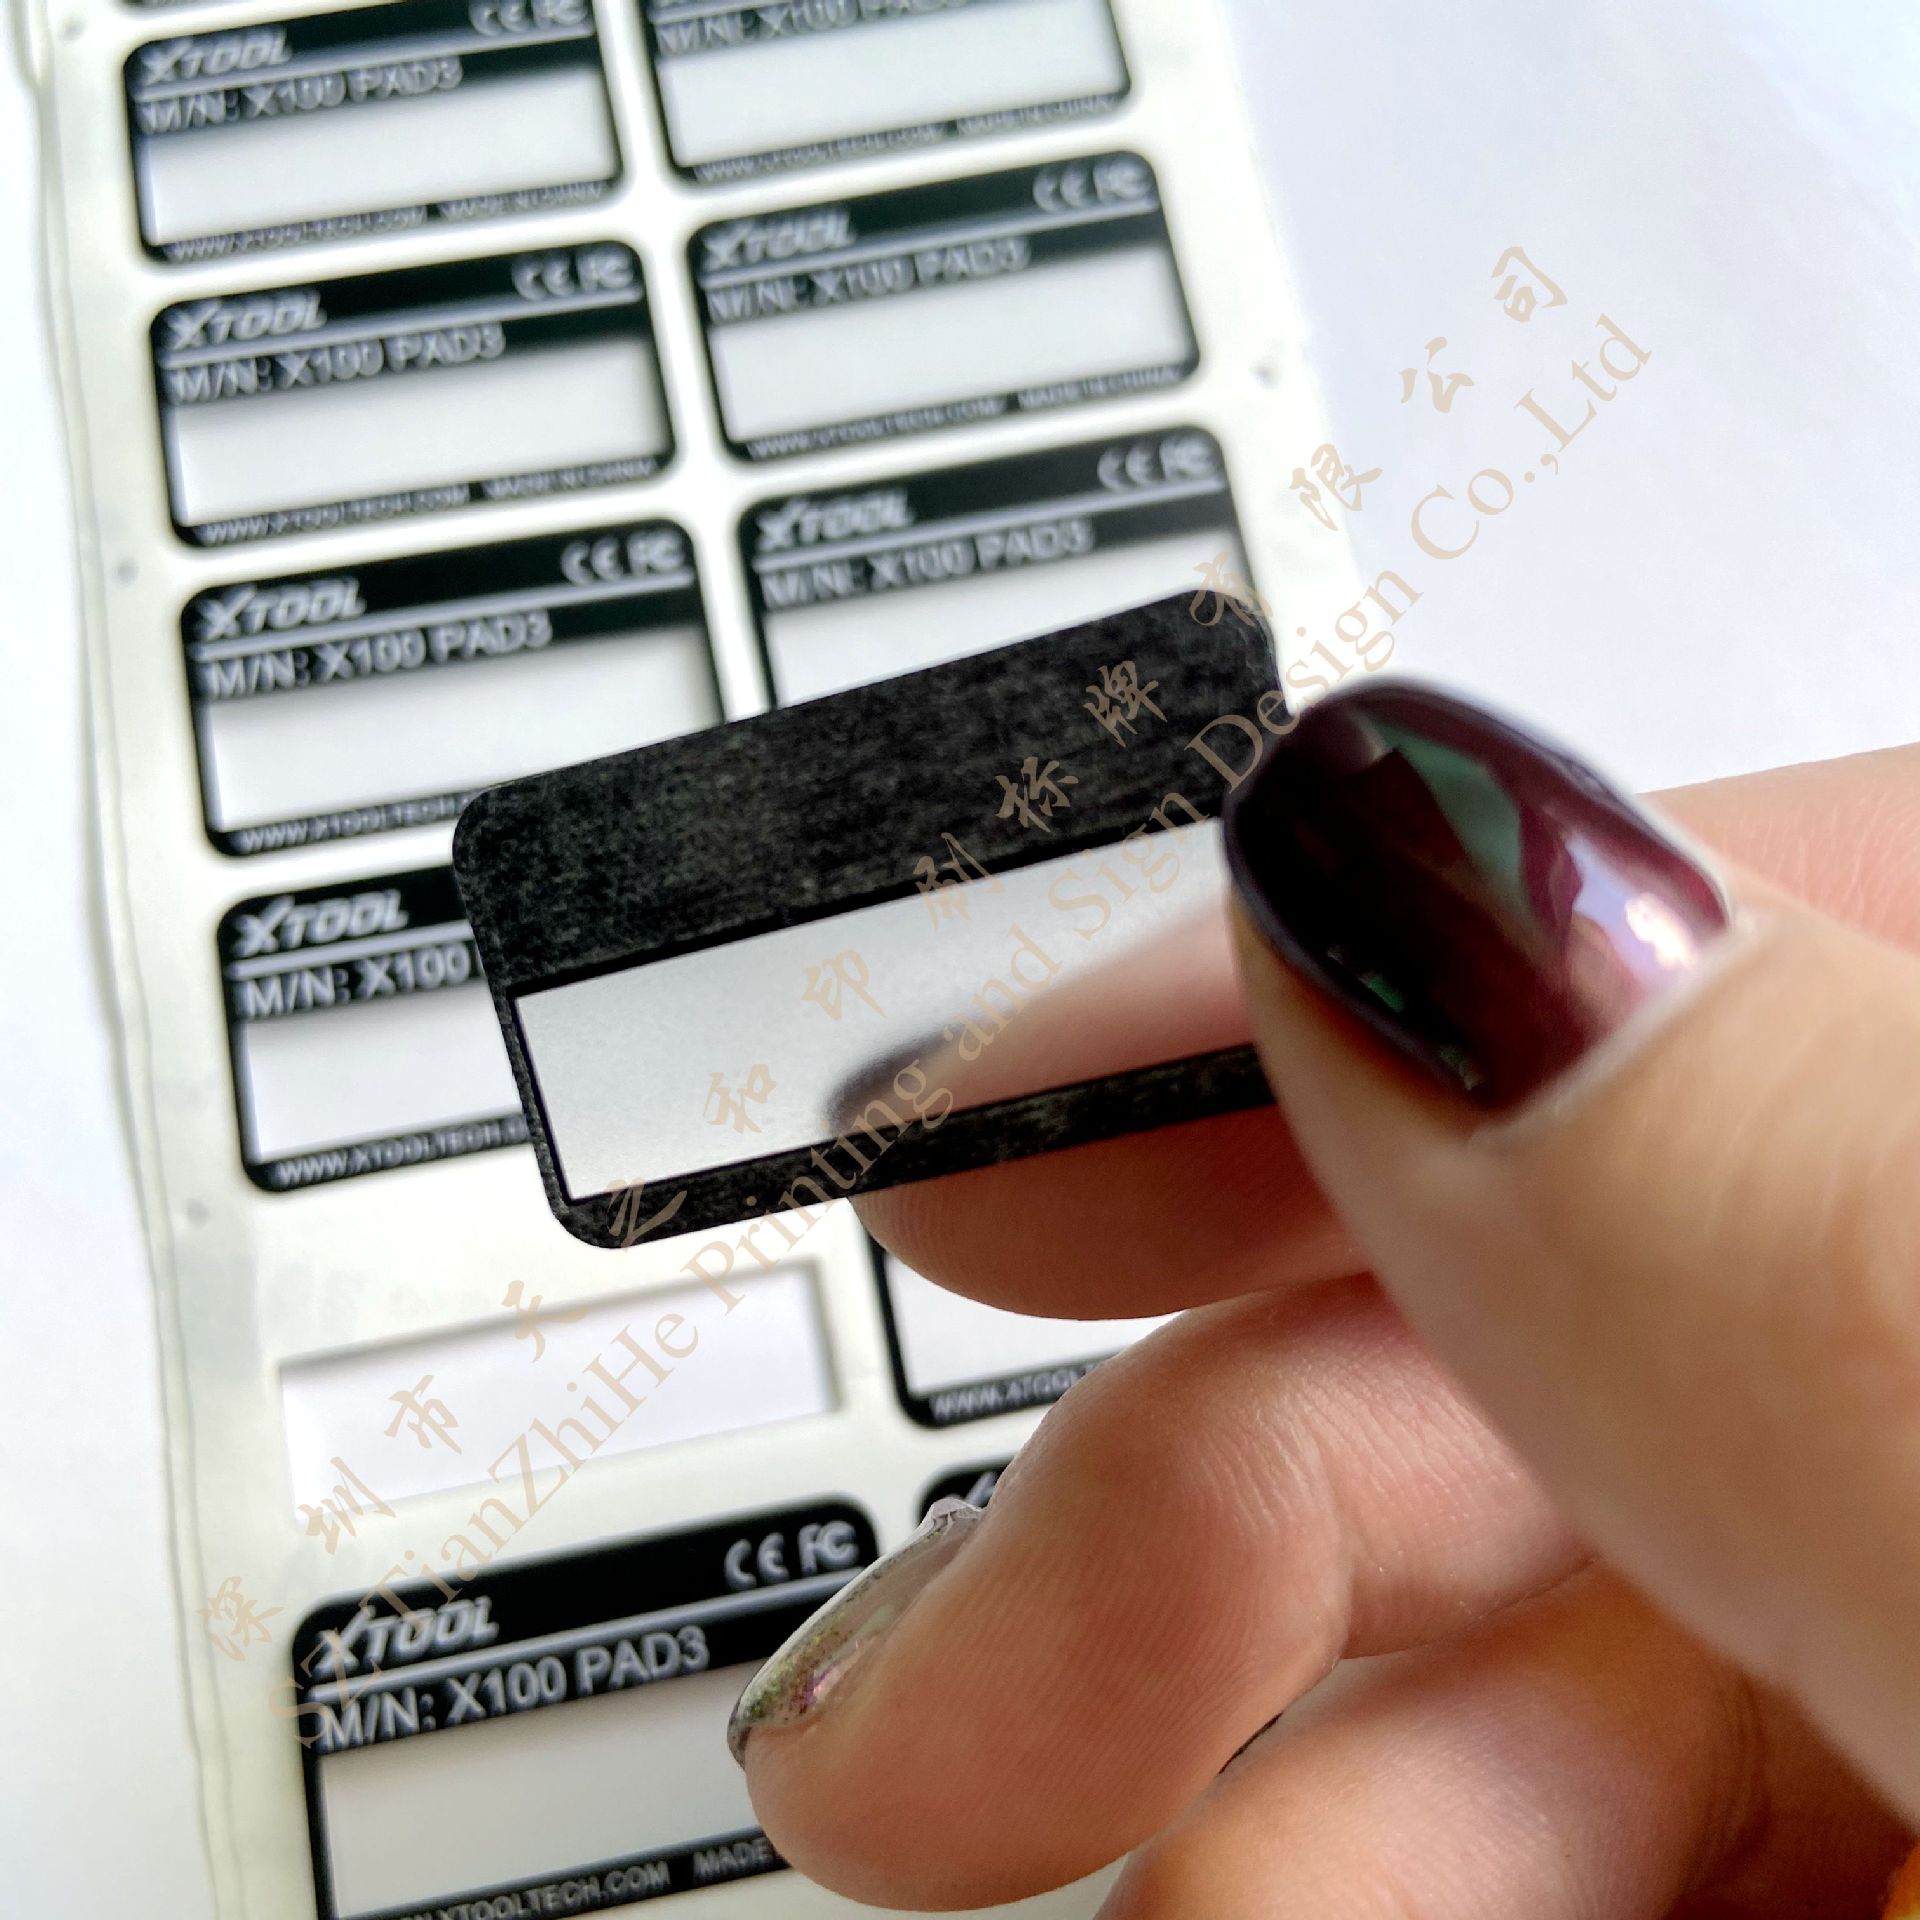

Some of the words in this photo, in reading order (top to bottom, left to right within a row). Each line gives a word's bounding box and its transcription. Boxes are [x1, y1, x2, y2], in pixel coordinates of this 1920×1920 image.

[142, 26, 292, 86] XTOOL
[168, 291, 327, 351] XTOOL
[169, 357, 272, 404] M/N:
[272, 337, 384, 390] X100
[385, 320, 506, 373] PAD3
[757, 491, 916, 552] XTOOL
[868, 537, 975, 590] X100
[976, 516, 1095, 573] PAD3
[199, 577, 366, 640] XTOOL
[206, 650, 310, 698] M/N:
[313, 627, 426, 683] X100
[429, 609, 553, 664] PAD3
[233, 889, 410, 957] XTOOL
[242, 965, 349, 1019] M/N:
[357, 944, 471, 999] X100
[313, 1596, 499, 1677] XTOOL
[318, 1687, 436, 1754] M/N:
[446, 1655, 567, 1726] X100
[574, 1627, 711, 1698] PAD3
[693, 1837, 773, 1887] MADE
